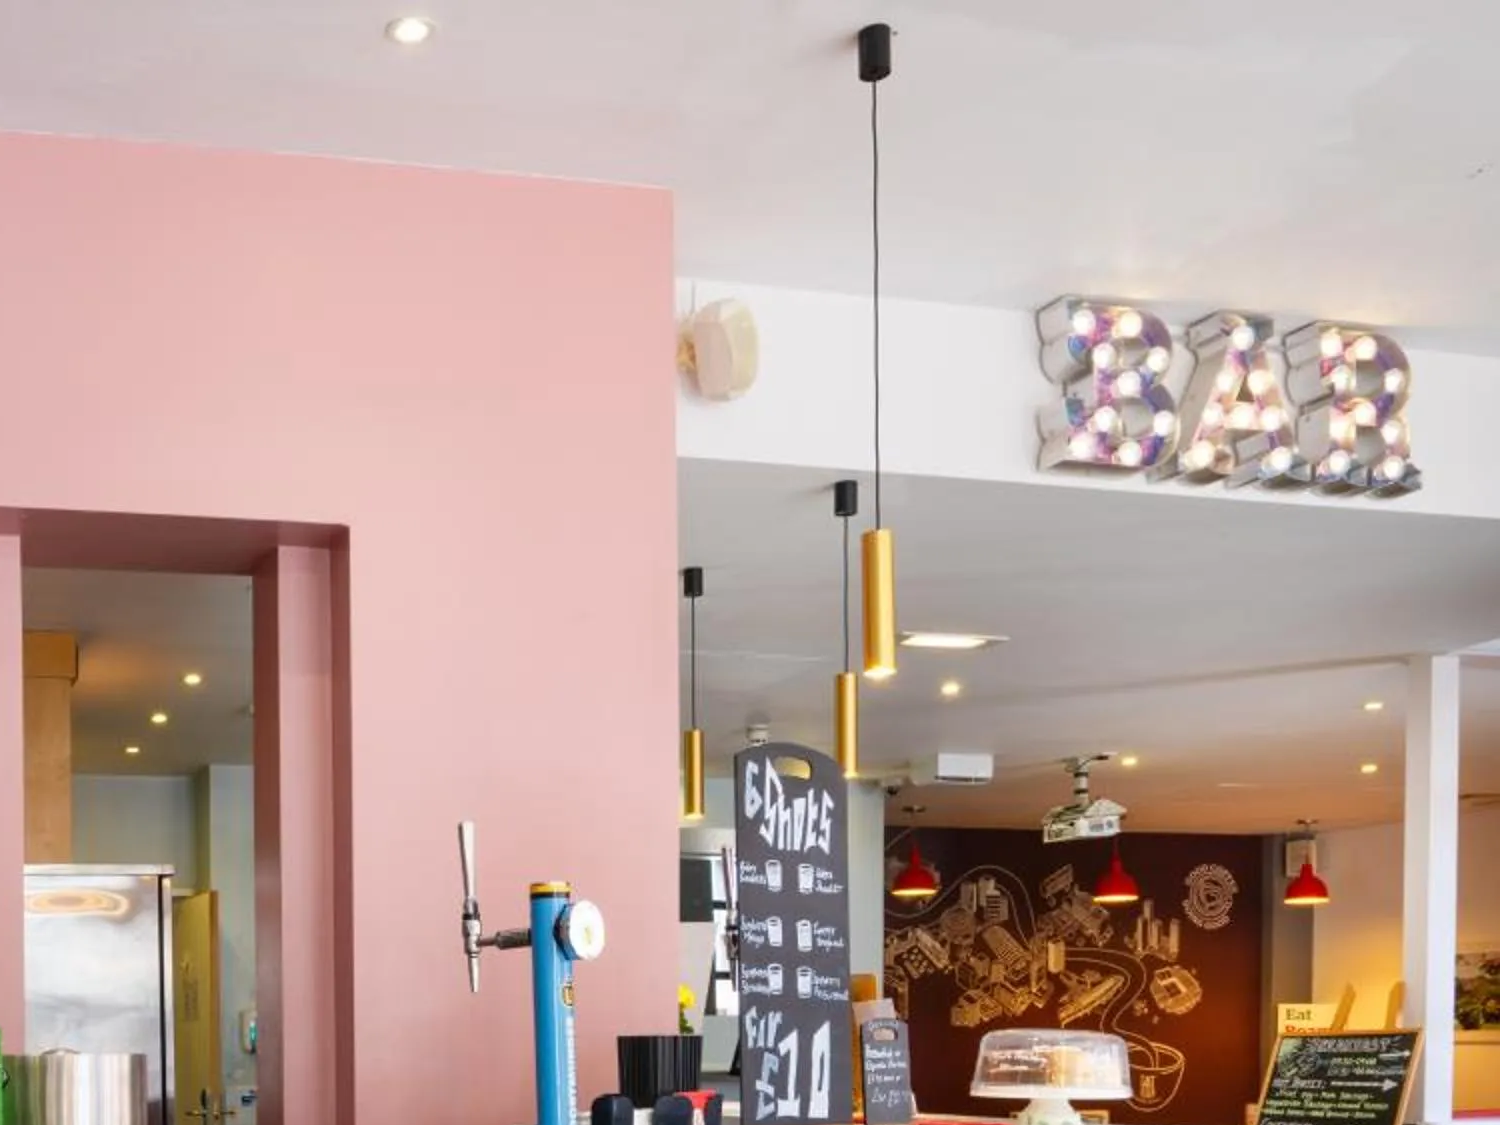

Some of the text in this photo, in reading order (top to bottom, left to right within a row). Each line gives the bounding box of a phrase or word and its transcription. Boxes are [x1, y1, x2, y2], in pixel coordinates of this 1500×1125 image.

[1036, 295, 1422, 498] BAR
[744, 760, 763, 820] 6
[1285, 1008, 1312, 1021] Eat
[755, 1019, 831, 1121] £10
